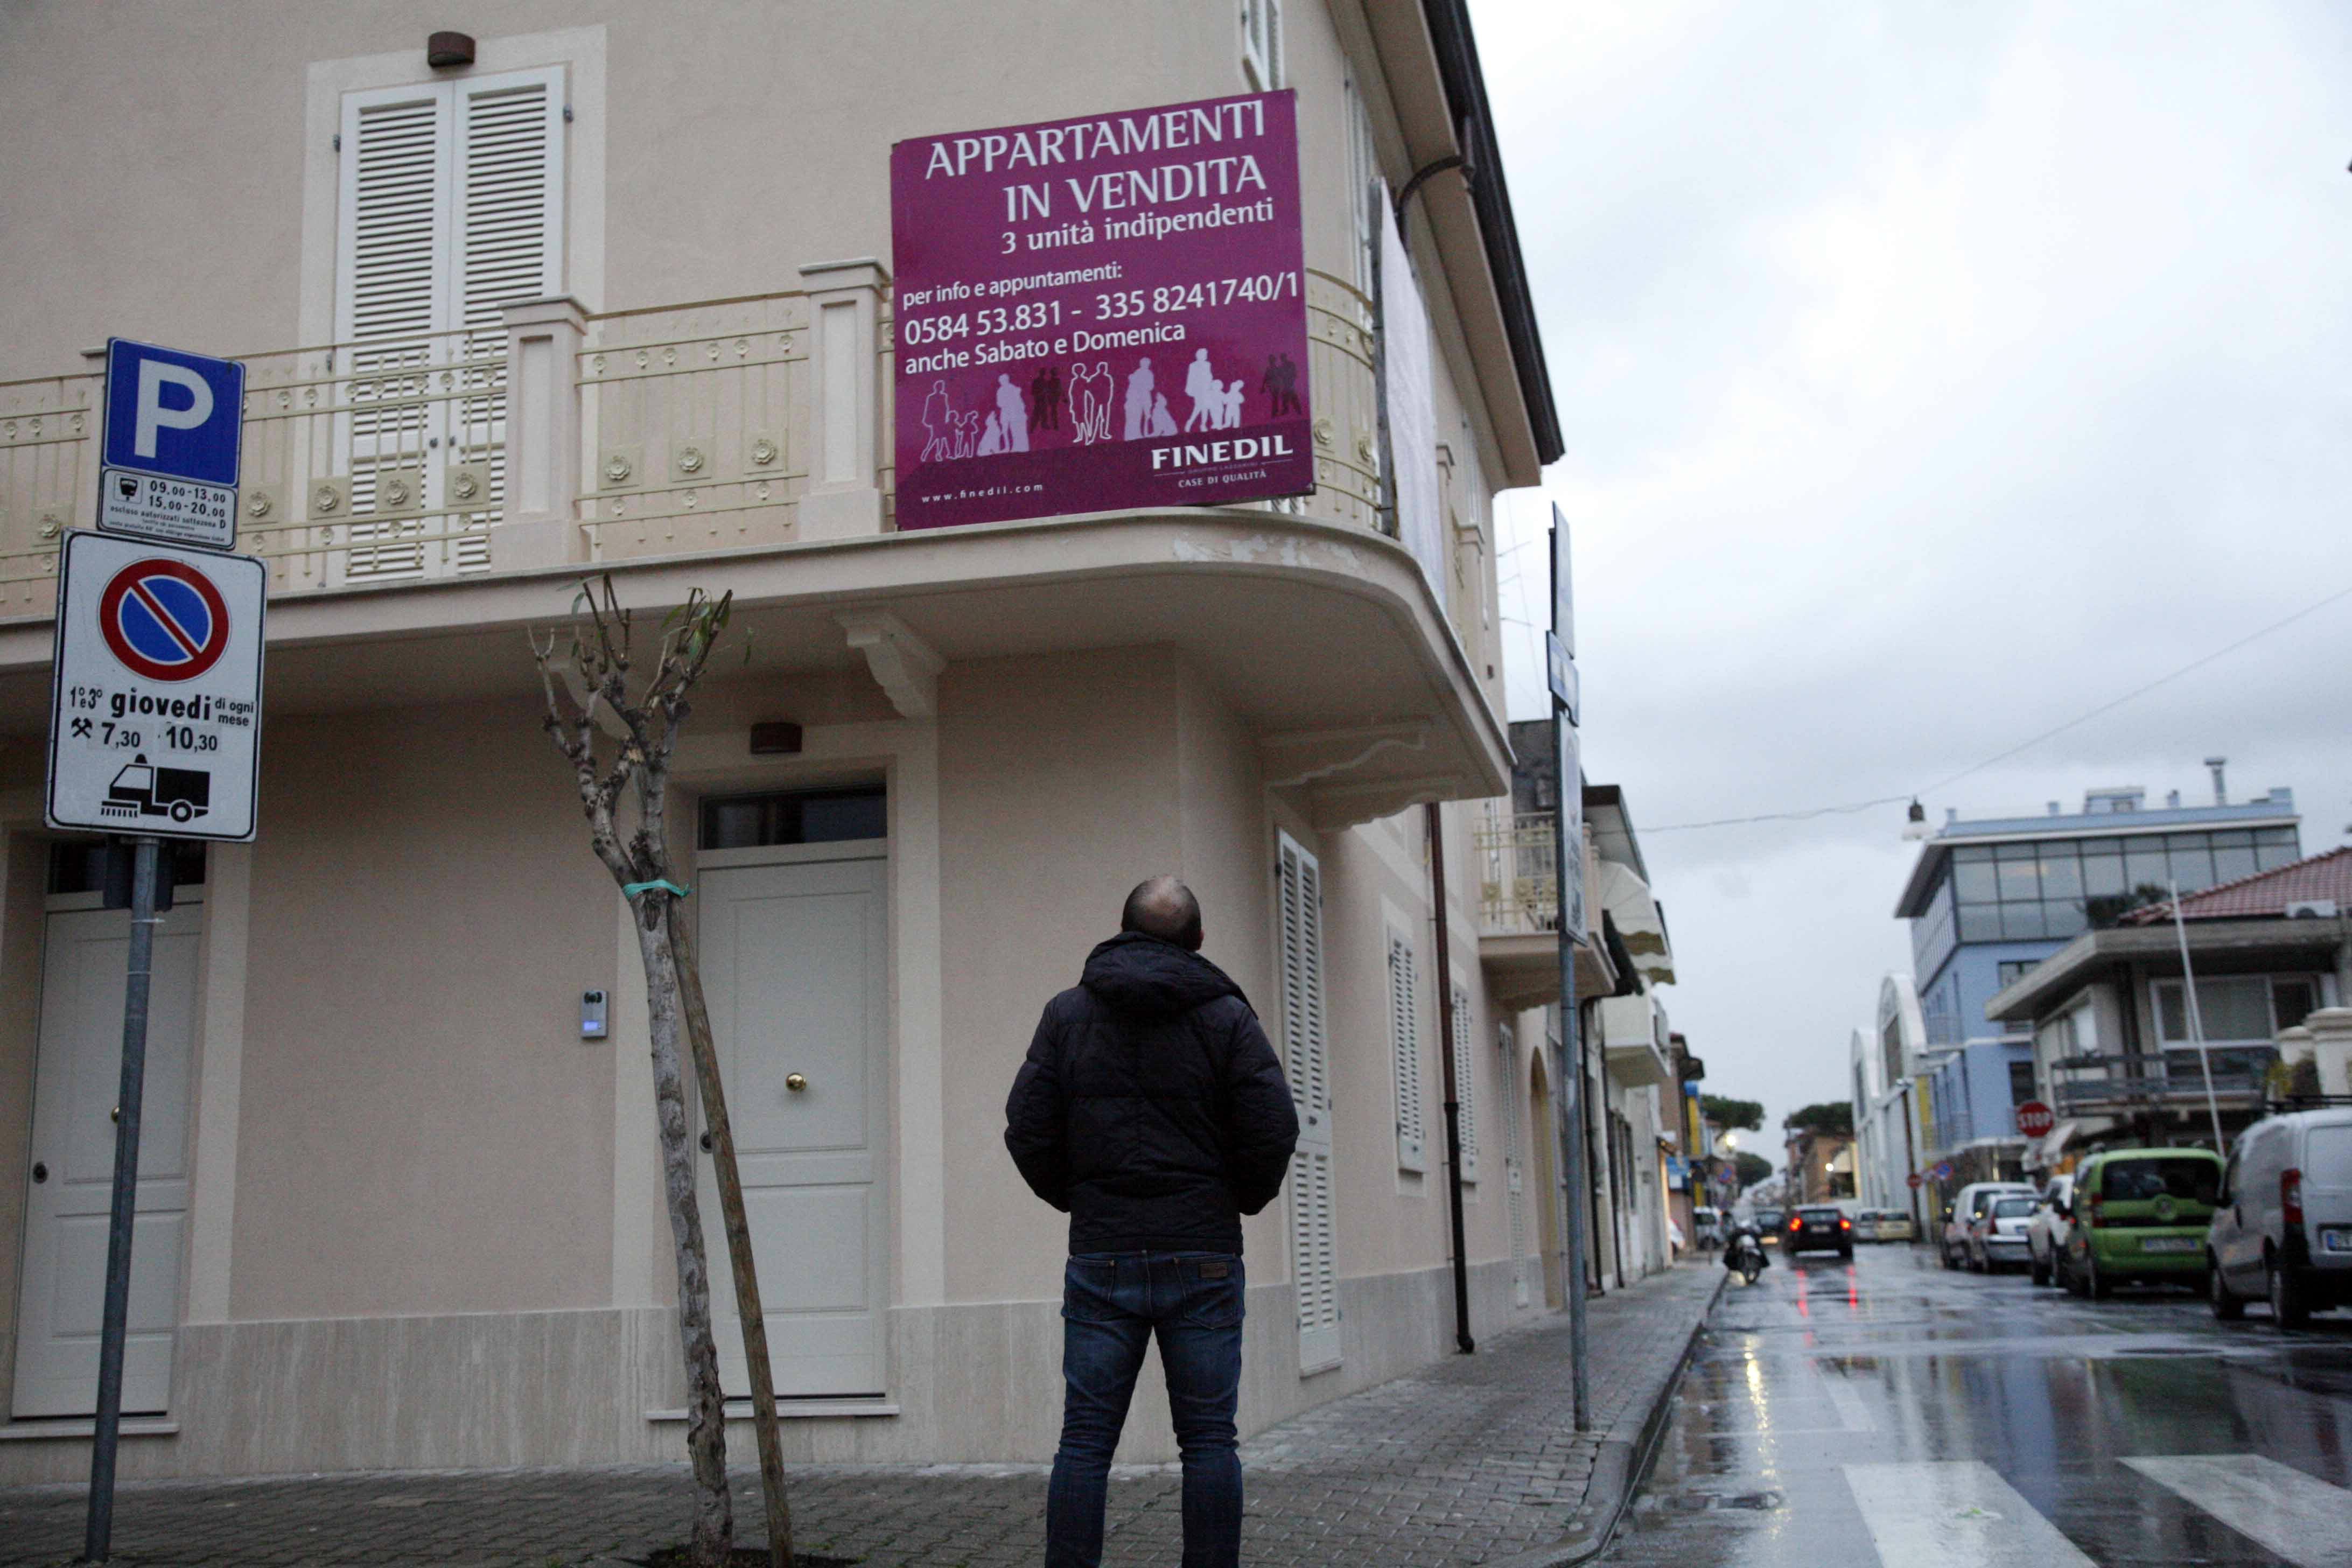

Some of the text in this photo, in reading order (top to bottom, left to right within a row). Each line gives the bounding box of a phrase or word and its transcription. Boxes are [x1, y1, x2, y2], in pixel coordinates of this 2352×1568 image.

[926, 100, 1264, 179] APPARTAMENTI
[1003, 155, 1267, 222] IN VENDITA
[1002, 197, 1273, 254] 3 unità indipendenti
[902, 261, 1123, 310] per info e appuntamenti:
[904, 313, 970, 345] 0584
[977, 300, 1061, 335] 53.831
[1095, 290, 1145, 320] 335
[1153, 271, 1297, 313] 8241740/1
[905, 321, 1186, 375] anche Sabato e Domenica
[134, 358, 214, 459] P
[1151, 435, 1293, 470] FINEDIL
[921, 484, 1043, 503] www.finedil.com
[1178, 468, 1267, 488] CASE DI QUALITÀ
[220, 519, 226, 529] D
[111, 687, 211, 720] giovedi
[215, 698, 225, 710] di
[229, 701, 254, 715] ogni
[218, 712, 249, 726] mese
[101, 722, 218, 753] 7,30 10,30
[2018, 1112, 2052, 1128] STOP
